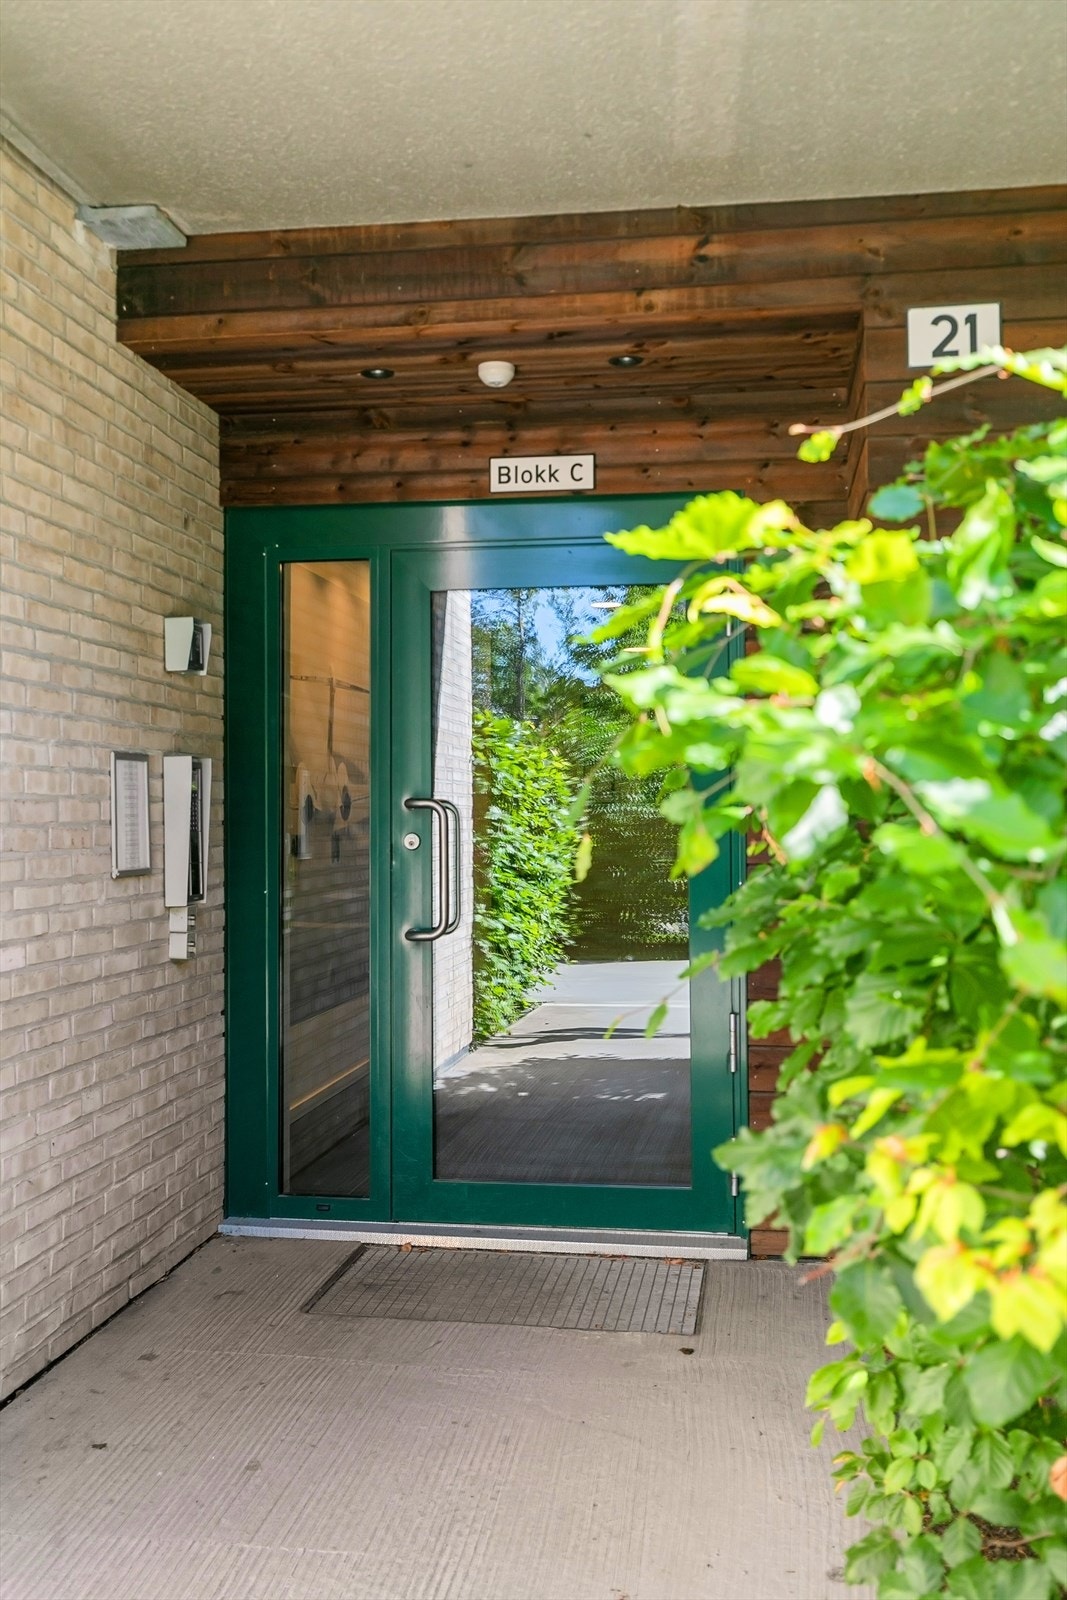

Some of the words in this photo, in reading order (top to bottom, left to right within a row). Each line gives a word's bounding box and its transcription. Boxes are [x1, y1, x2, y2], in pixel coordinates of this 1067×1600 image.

[930, 313, 977, 358] 21
[498, 464, 560, 484] Blokk
[570, 463, 583, 482] C
